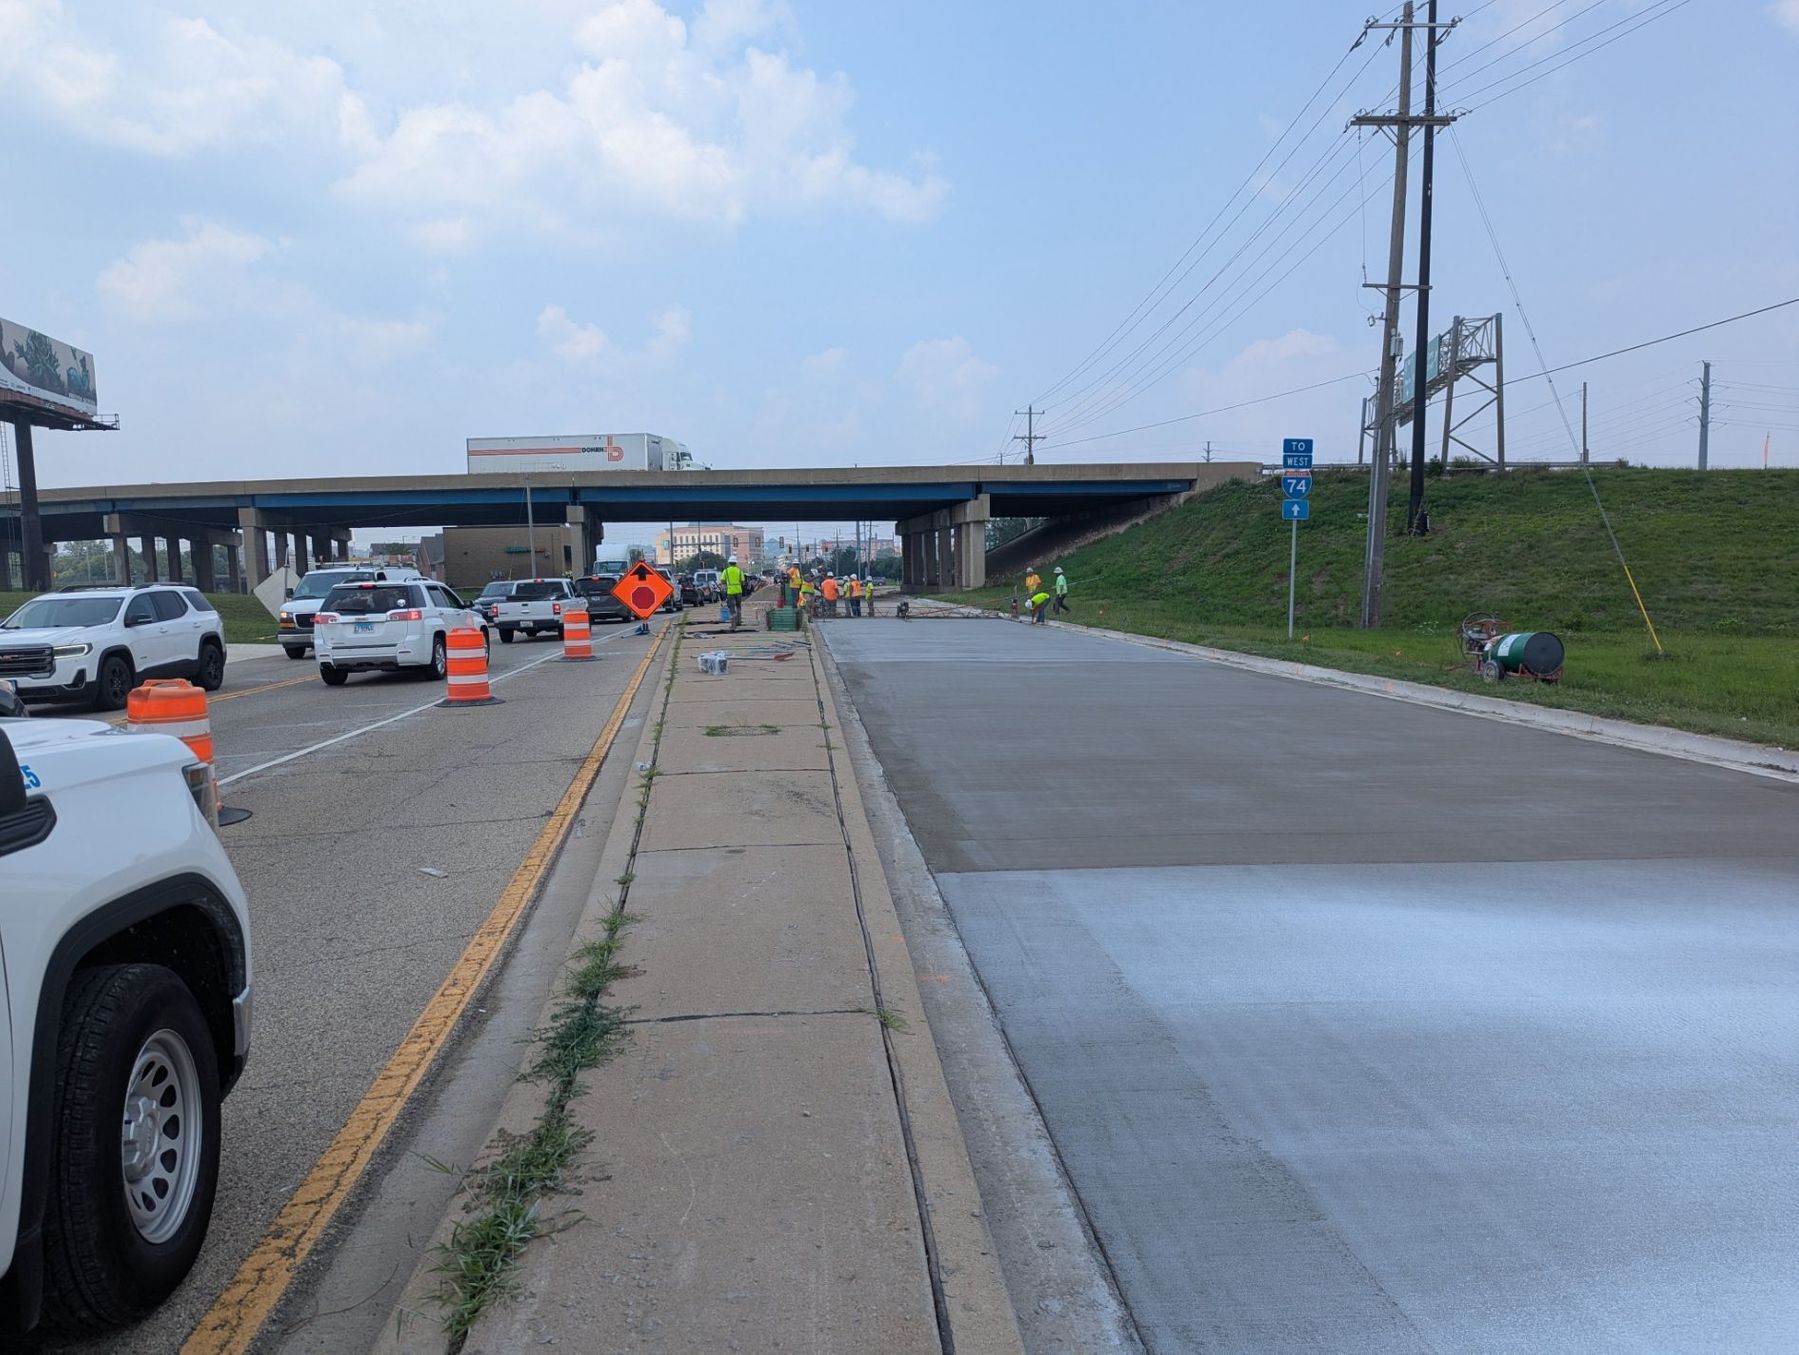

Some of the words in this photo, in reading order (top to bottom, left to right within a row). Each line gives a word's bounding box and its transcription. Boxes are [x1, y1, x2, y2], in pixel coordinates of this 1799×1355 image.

[1291, 441, 1306, 451] TO
[1287, 457, 1308, 466] WEST
[1287, 479, 1307, 494] 74
[20, 765, 41, 789] 5
